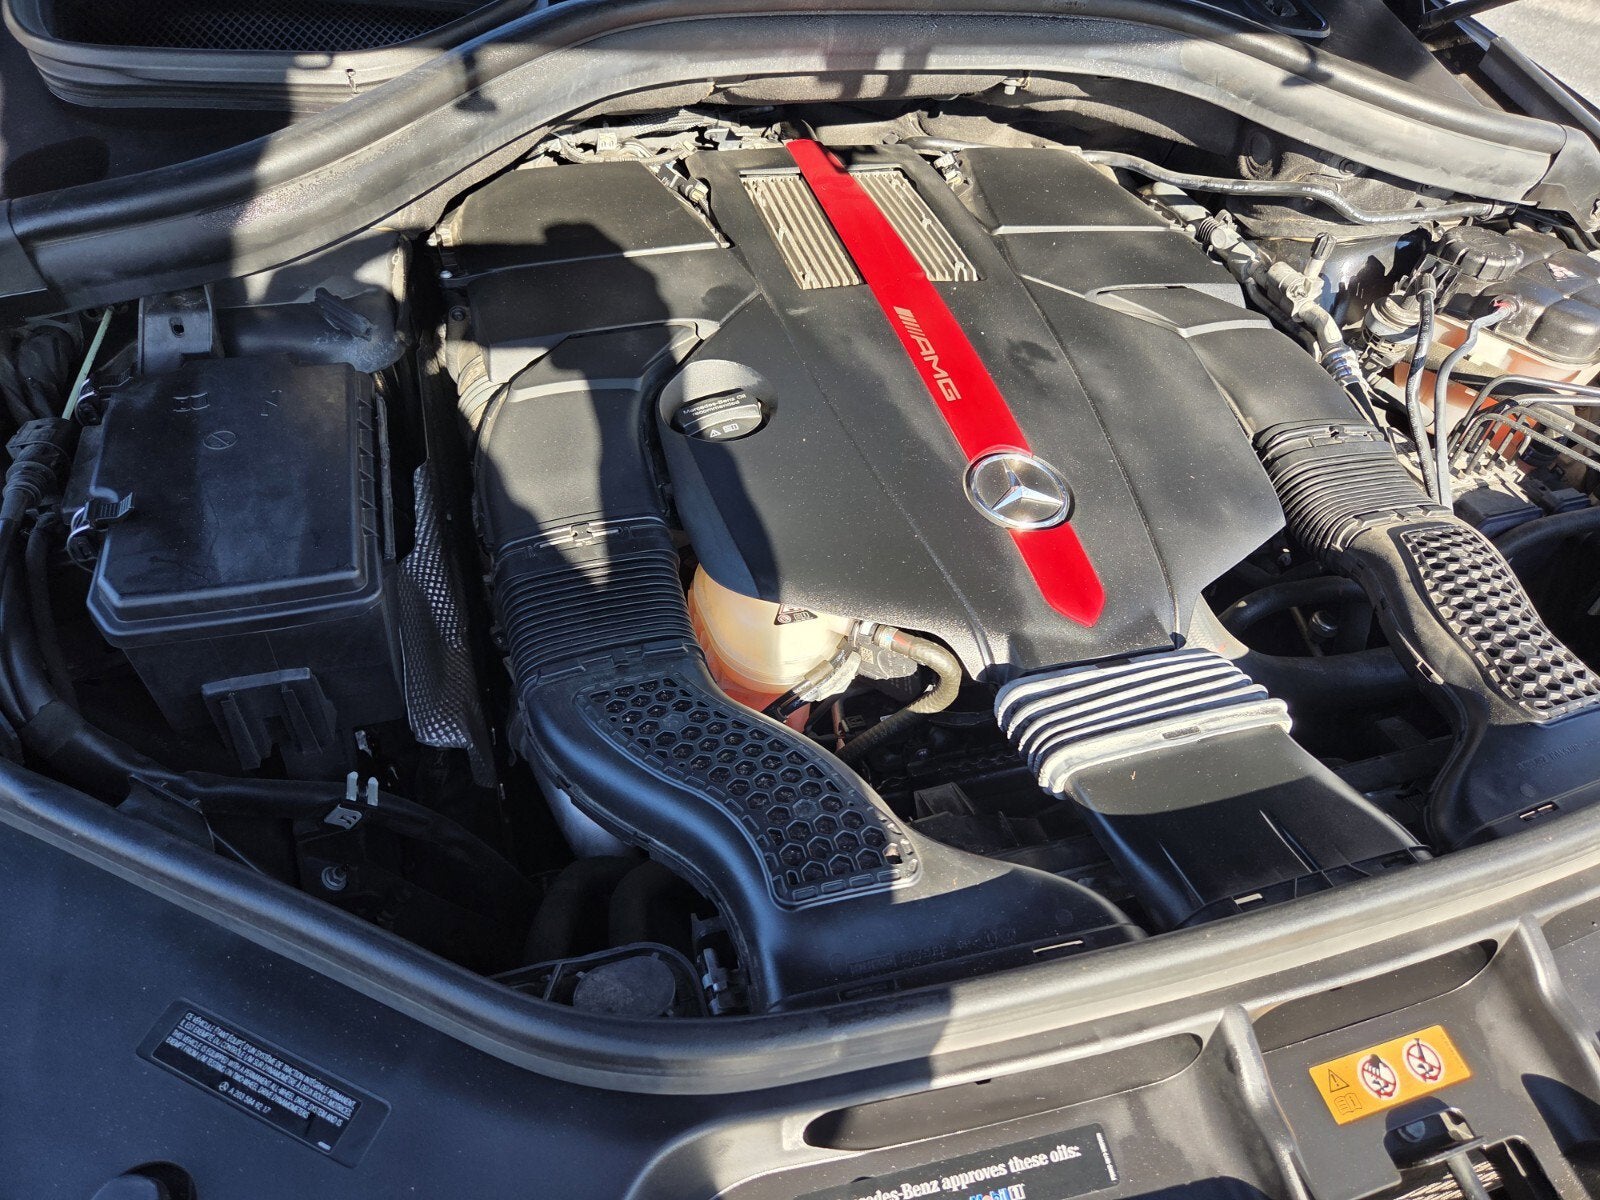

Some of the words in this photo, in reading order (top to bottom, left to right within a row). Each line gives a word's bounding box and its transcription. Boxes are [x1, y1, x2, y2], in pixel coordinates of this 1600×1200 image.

[692, 400, 740, 416] recommended
[853, 1180, 940, 1200] des-Benz
[941, 1163, 1008, 1192] approves
[1008, 1153, 1049, 1173] these
[1049, 1144, 1082, 1163] oils:
